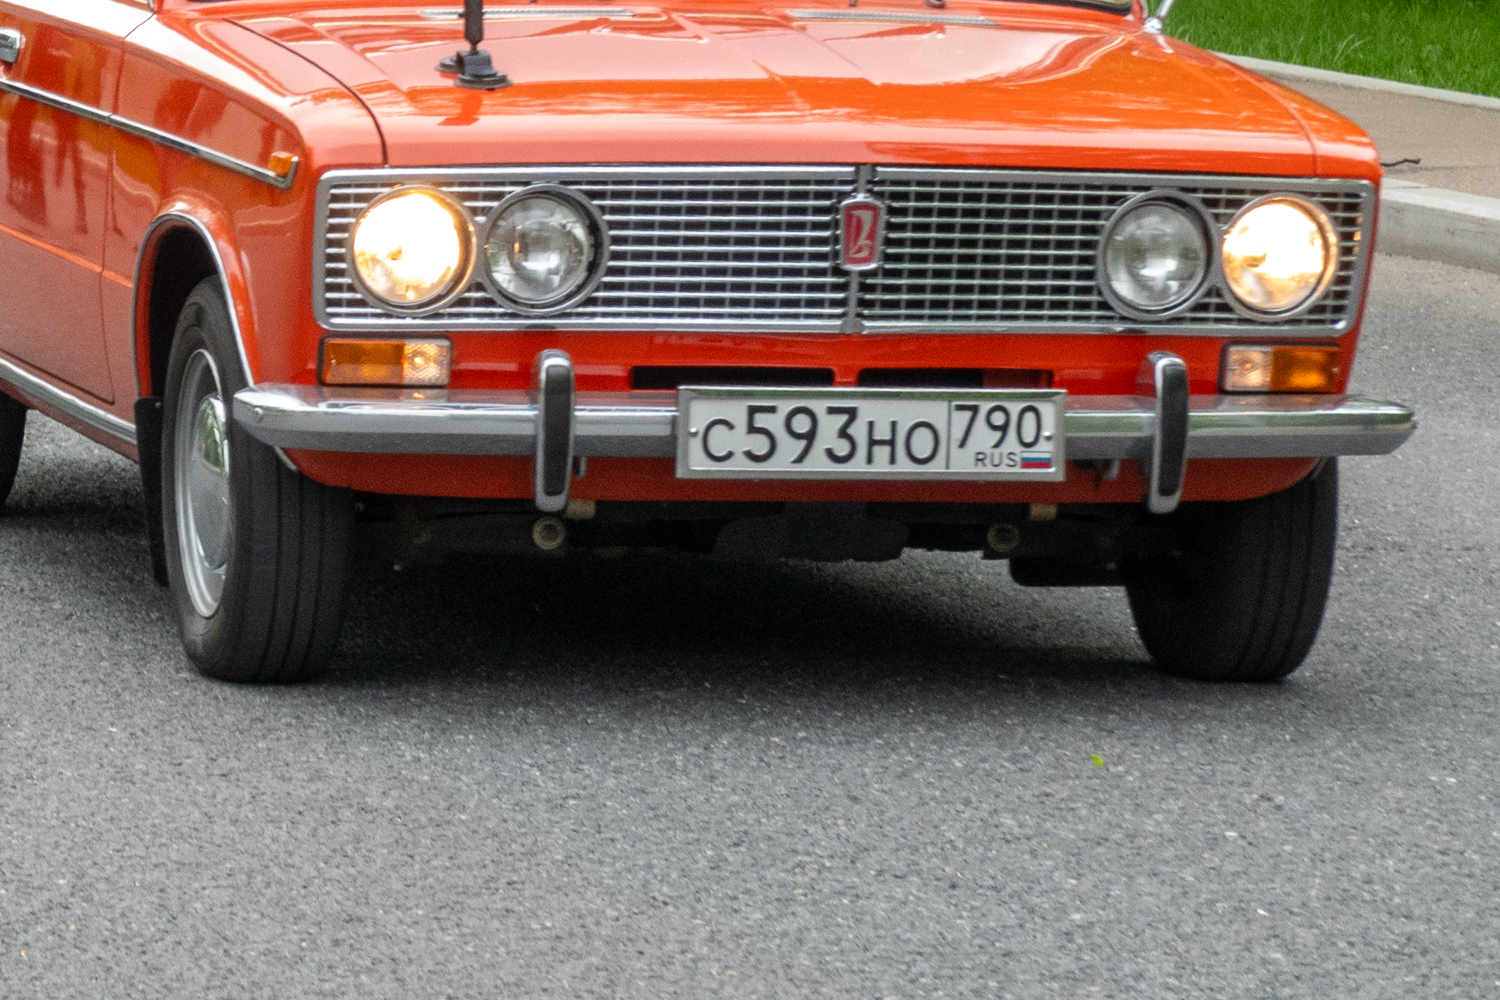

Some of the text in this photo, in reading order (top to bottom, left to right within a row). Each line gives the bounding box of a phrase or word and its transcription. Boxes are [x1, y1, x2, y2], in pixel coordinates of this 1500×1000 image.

[702, 403, 1043, 466] С593НО 790
[974, 451, 1018, 468] RUS
